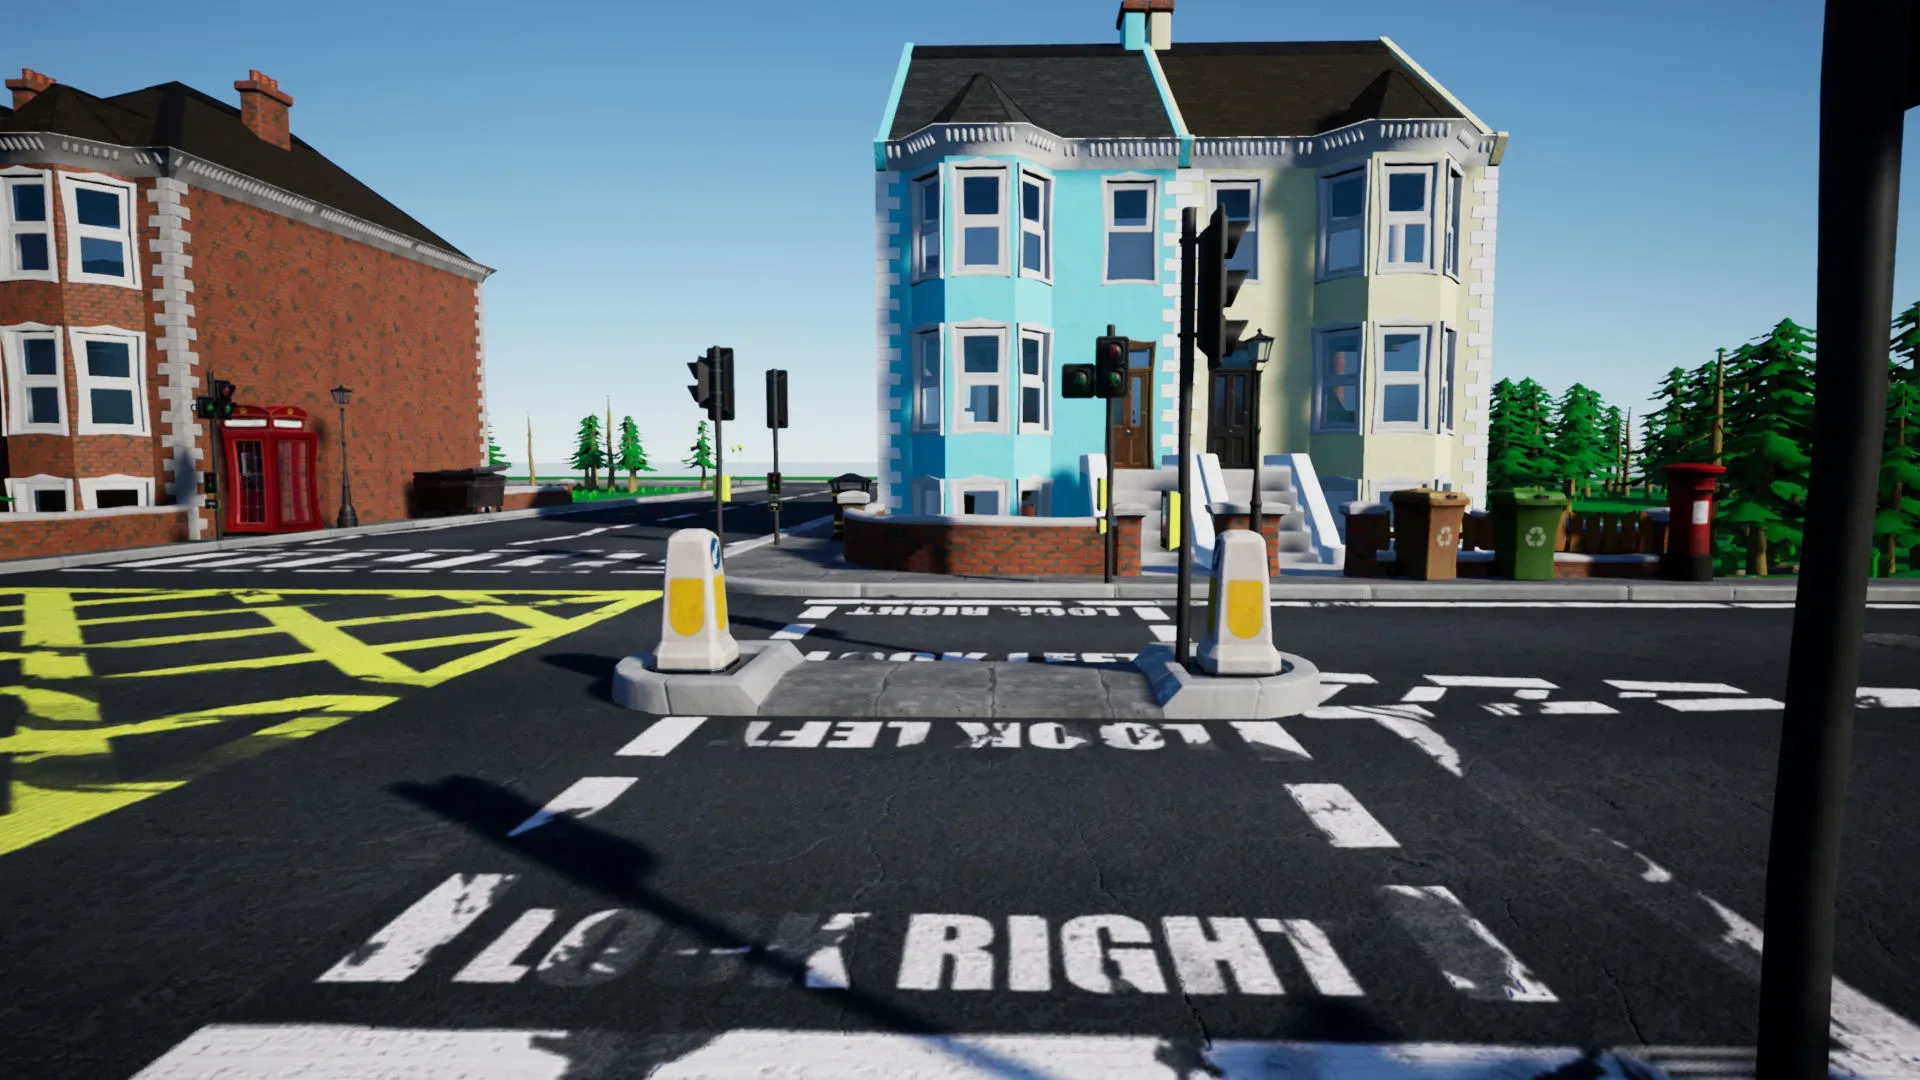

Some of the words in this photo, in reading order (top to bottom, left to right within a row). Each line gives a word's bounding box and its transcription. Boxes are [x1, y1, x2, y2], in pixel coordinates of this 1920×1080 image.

[845, 606, 990, 617] RIGHT
[744, 720, 932, 749] LEFT
[956, 721, 1213, 750] LOOK
[451, 908, 873, 989] LOK
[896, 912, 1366, 997] RIGHT
